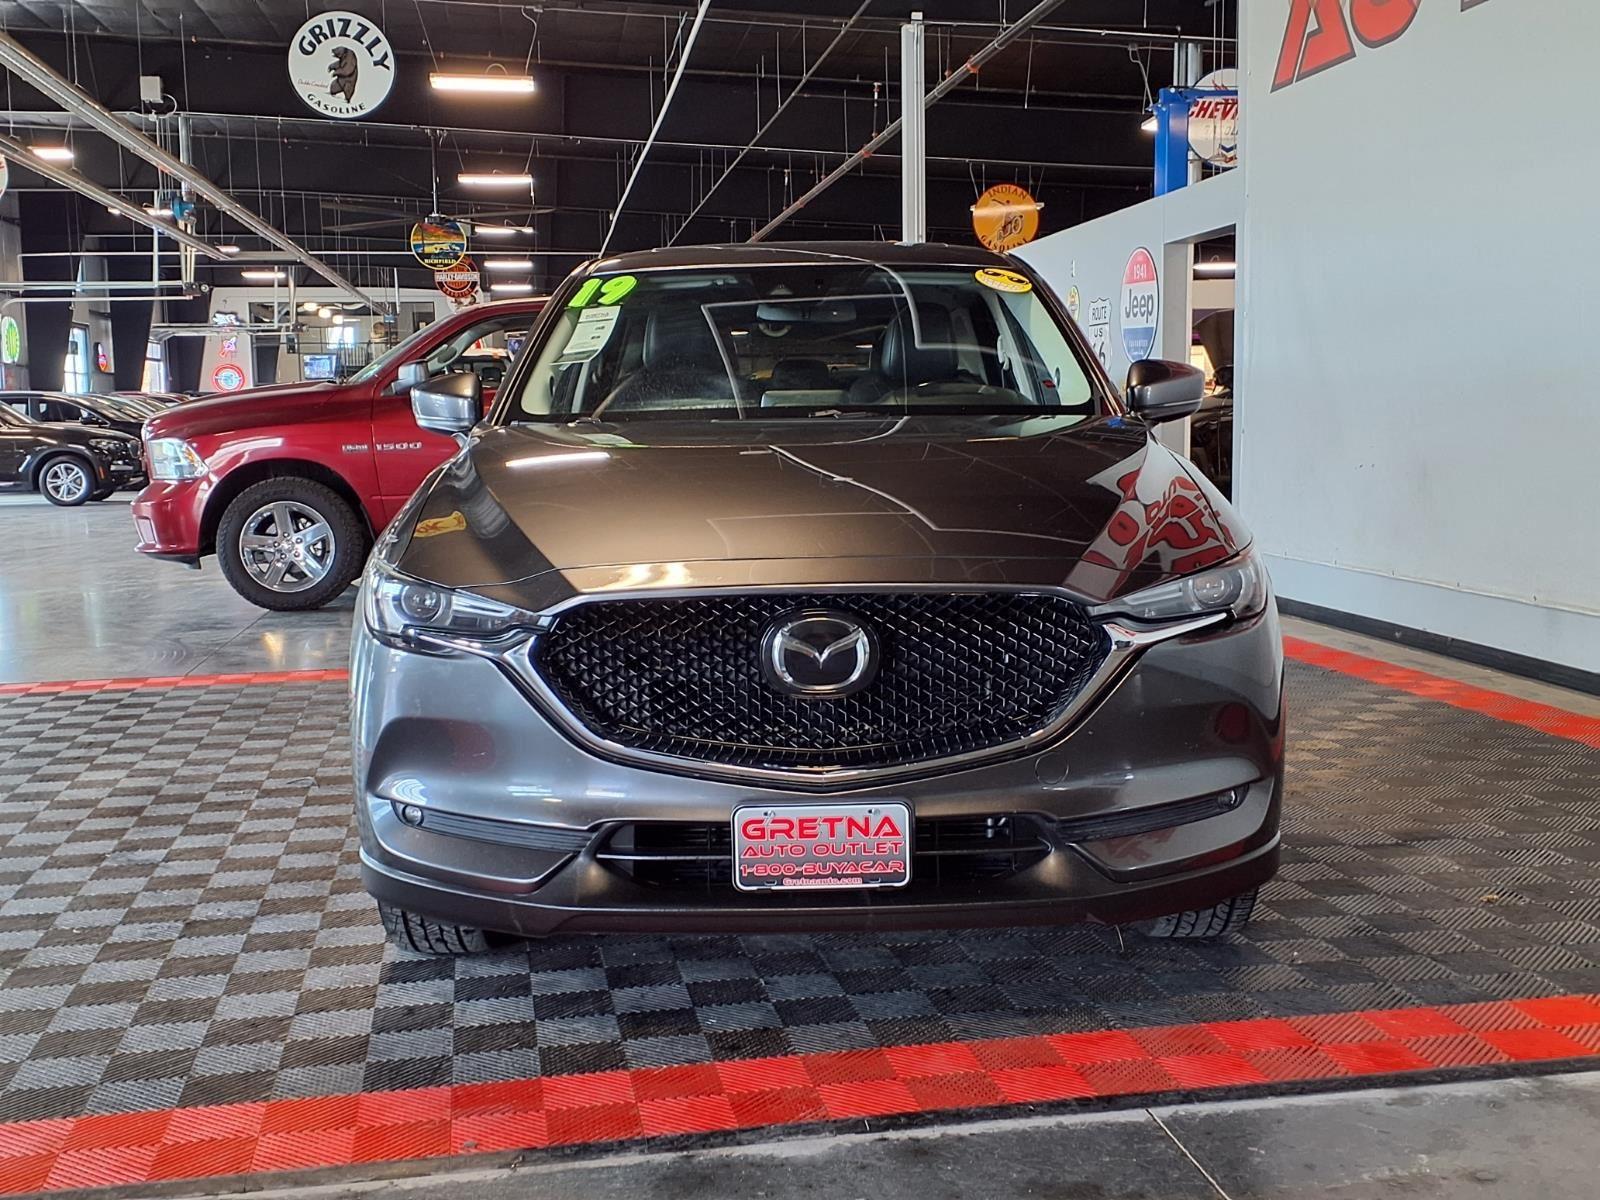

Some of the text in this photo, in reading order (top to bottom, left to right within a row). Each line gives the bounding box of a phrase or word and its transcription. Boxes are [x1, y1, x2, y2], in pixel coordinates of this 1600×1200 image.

[298, 17, 391, 71] GRIZZLY
[307, 93, 367, 114] GASOLINE
[1188, 99, 1238, 121] CHEV
[988, 185, 1028, 200] INDIAN
[1133, 263, 1147, 280] 1941
[567, 275, 638, 308] 19
[1091, 305, 1107, 321] ROUTE
[1124, 288, 1154, 323] Jeep
[1093, 327, 1103, 338] US
[376, 441, 422, 451] 1500
[741, 815, 903, 842] GRETNA
[740, 841, 904, 859] AUTO OUTLET
[740, 860, 904, 877] 1-800-BUYACAR
